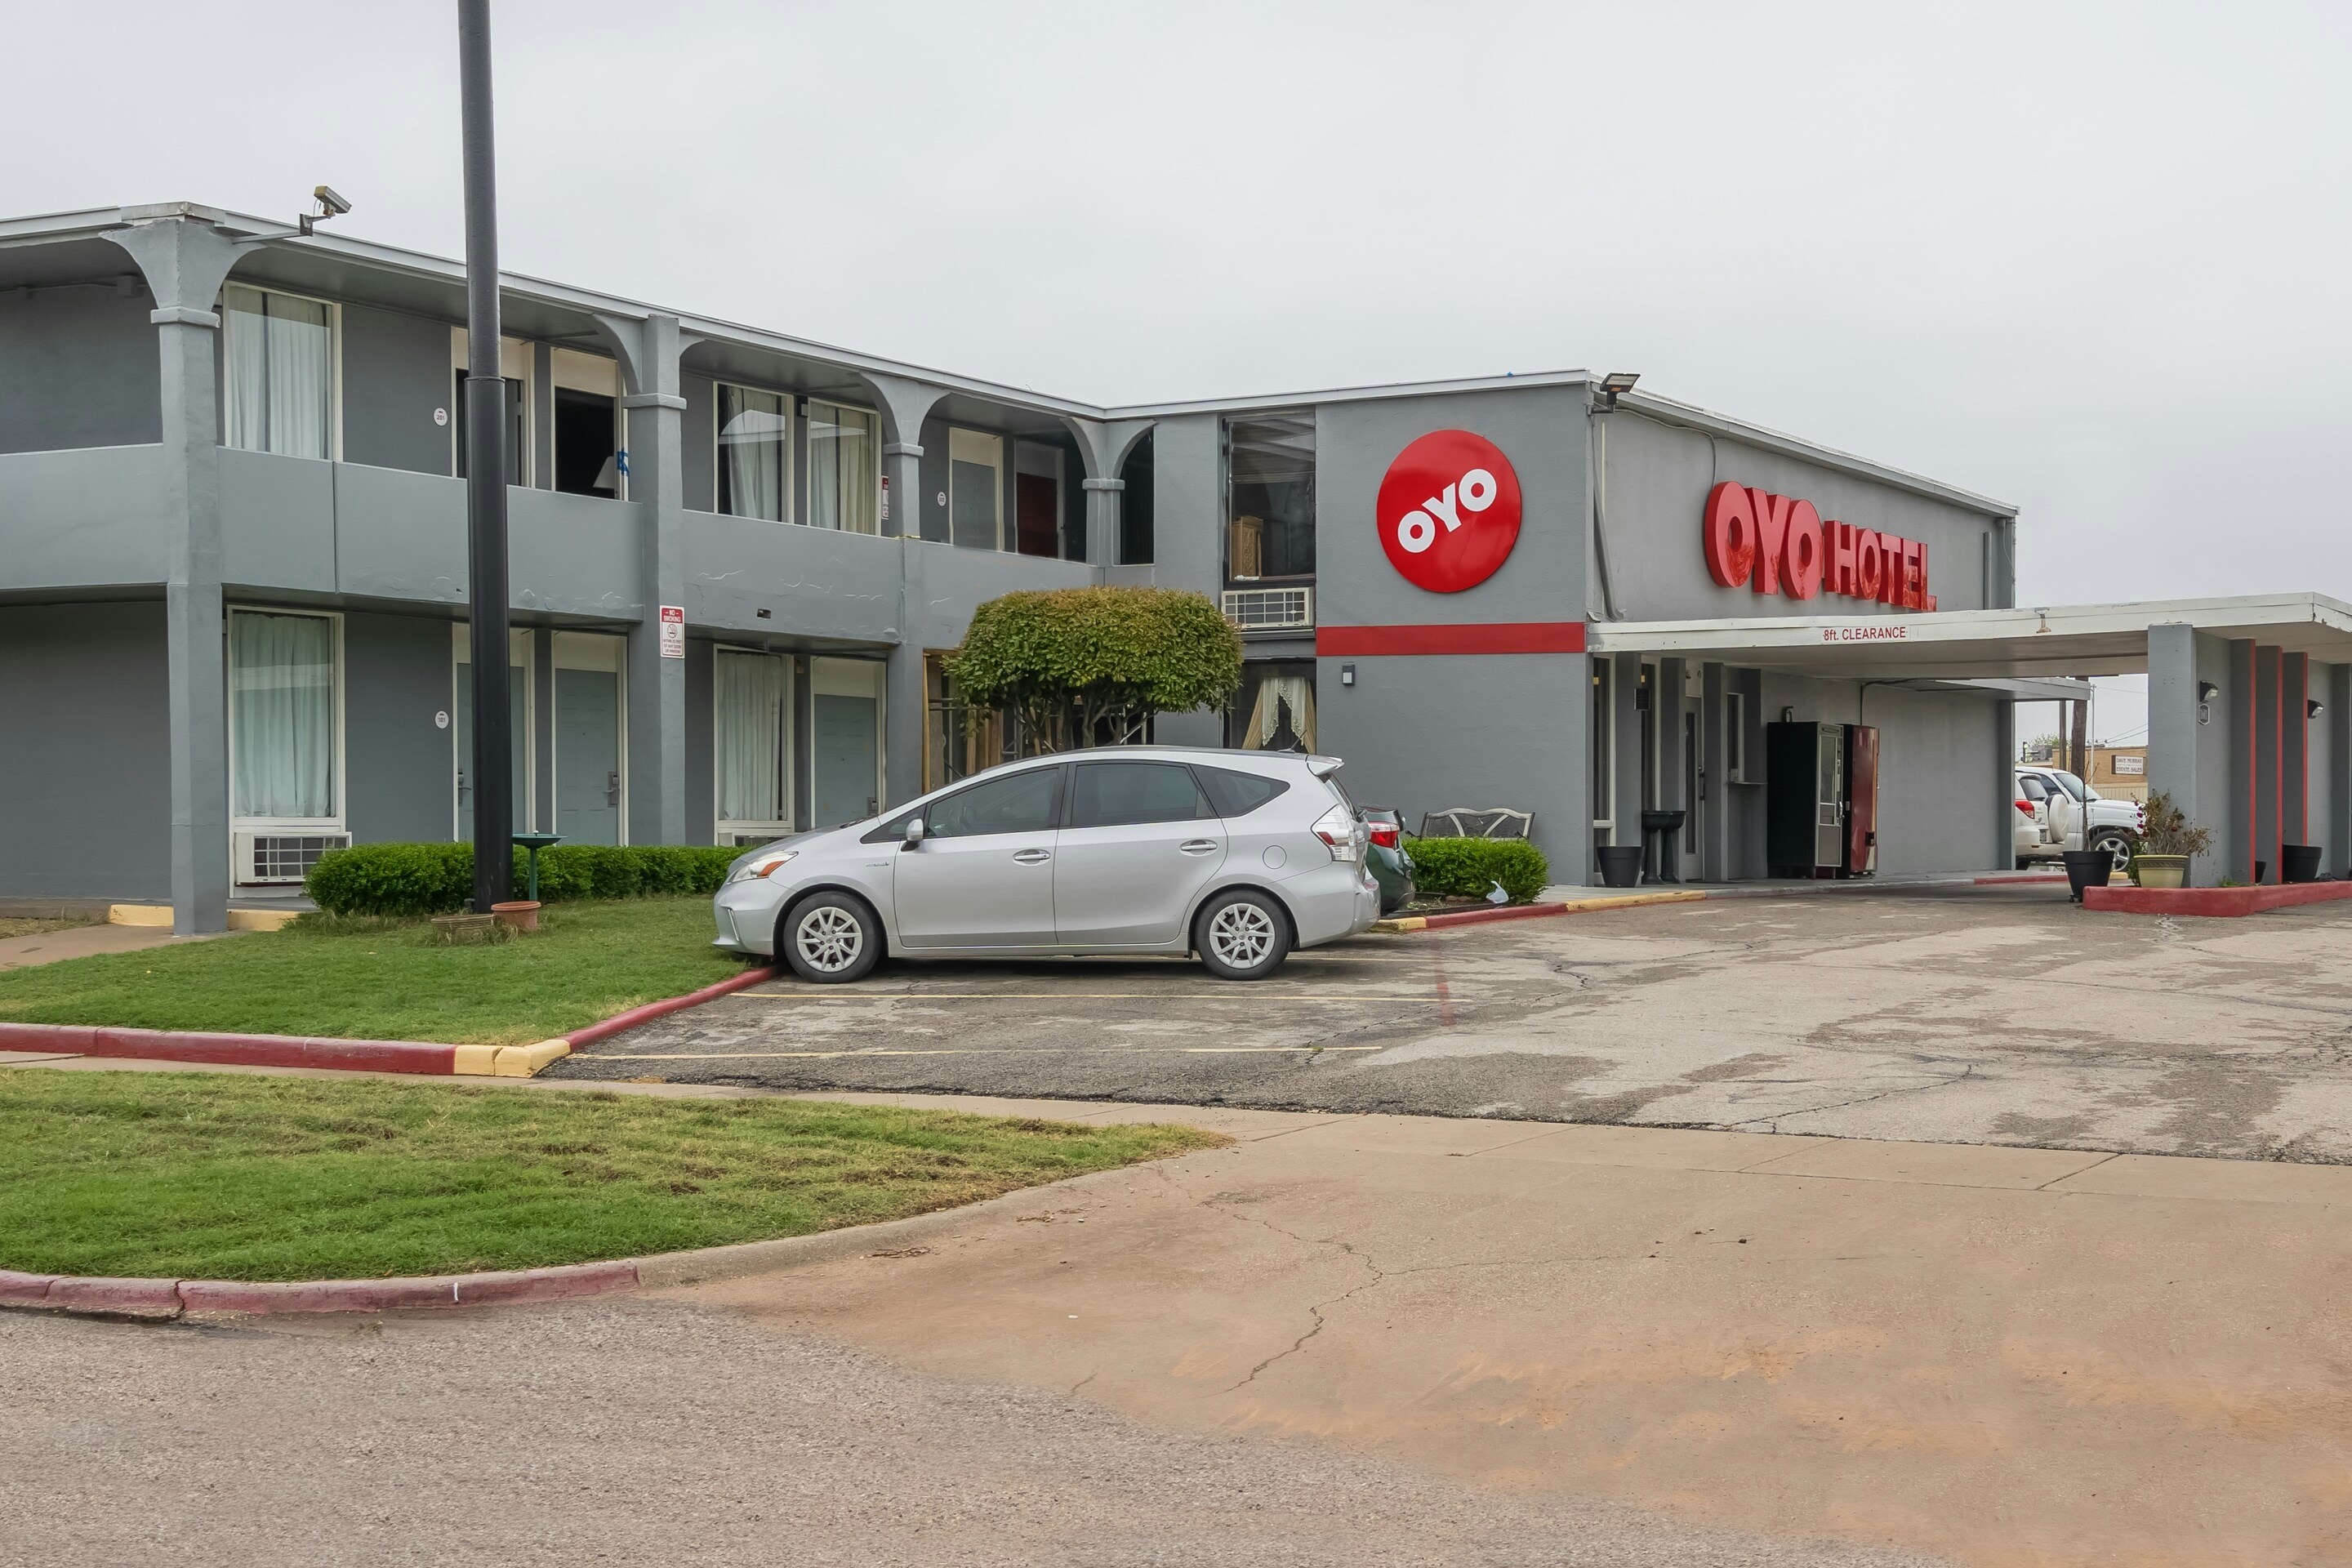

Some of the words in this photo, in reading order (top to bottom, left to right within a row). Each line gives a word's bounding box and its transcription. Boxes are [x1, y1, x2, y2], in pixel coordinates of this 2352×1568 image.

[1397, 468, 1497, 553] OYO
[1705, 481, 1823, 600] OYO
[1824, 520, 1936, 612] HOTEL
[1824, 629, 1839, 641] 8ft.
[1842, 626, 1906, 640] CLEARANCE
